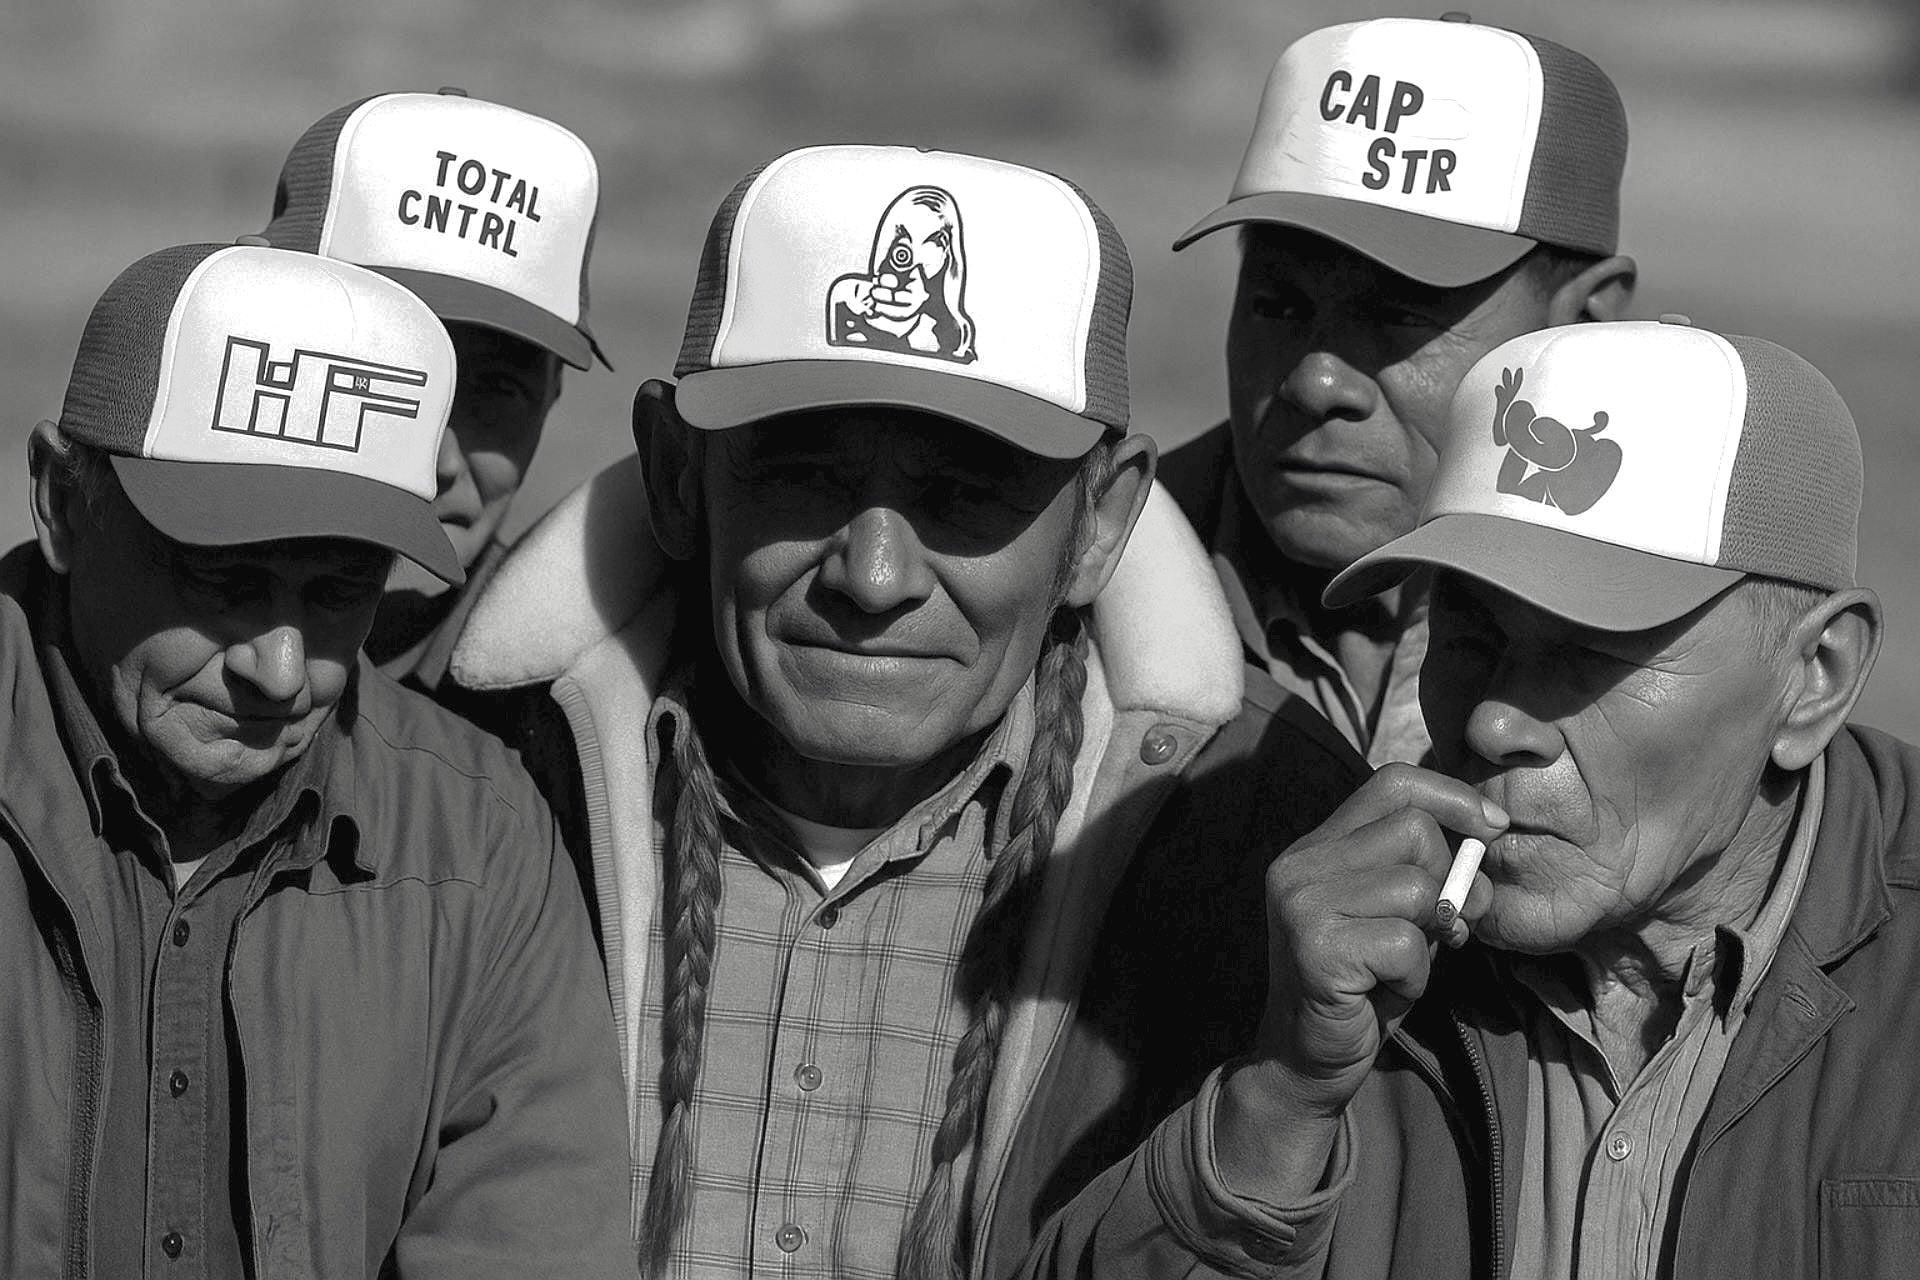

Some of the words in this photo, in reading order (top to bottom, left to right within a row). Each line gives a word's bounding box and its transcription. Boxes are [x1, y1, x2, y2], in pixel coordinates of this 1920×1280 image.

[1320, 70, 1424, 134] CAP
[436, 150, 542, 223] TOTAL
[1362, 137, 1457, 194] STR
[398, 189, 518, 257] CNTRL
